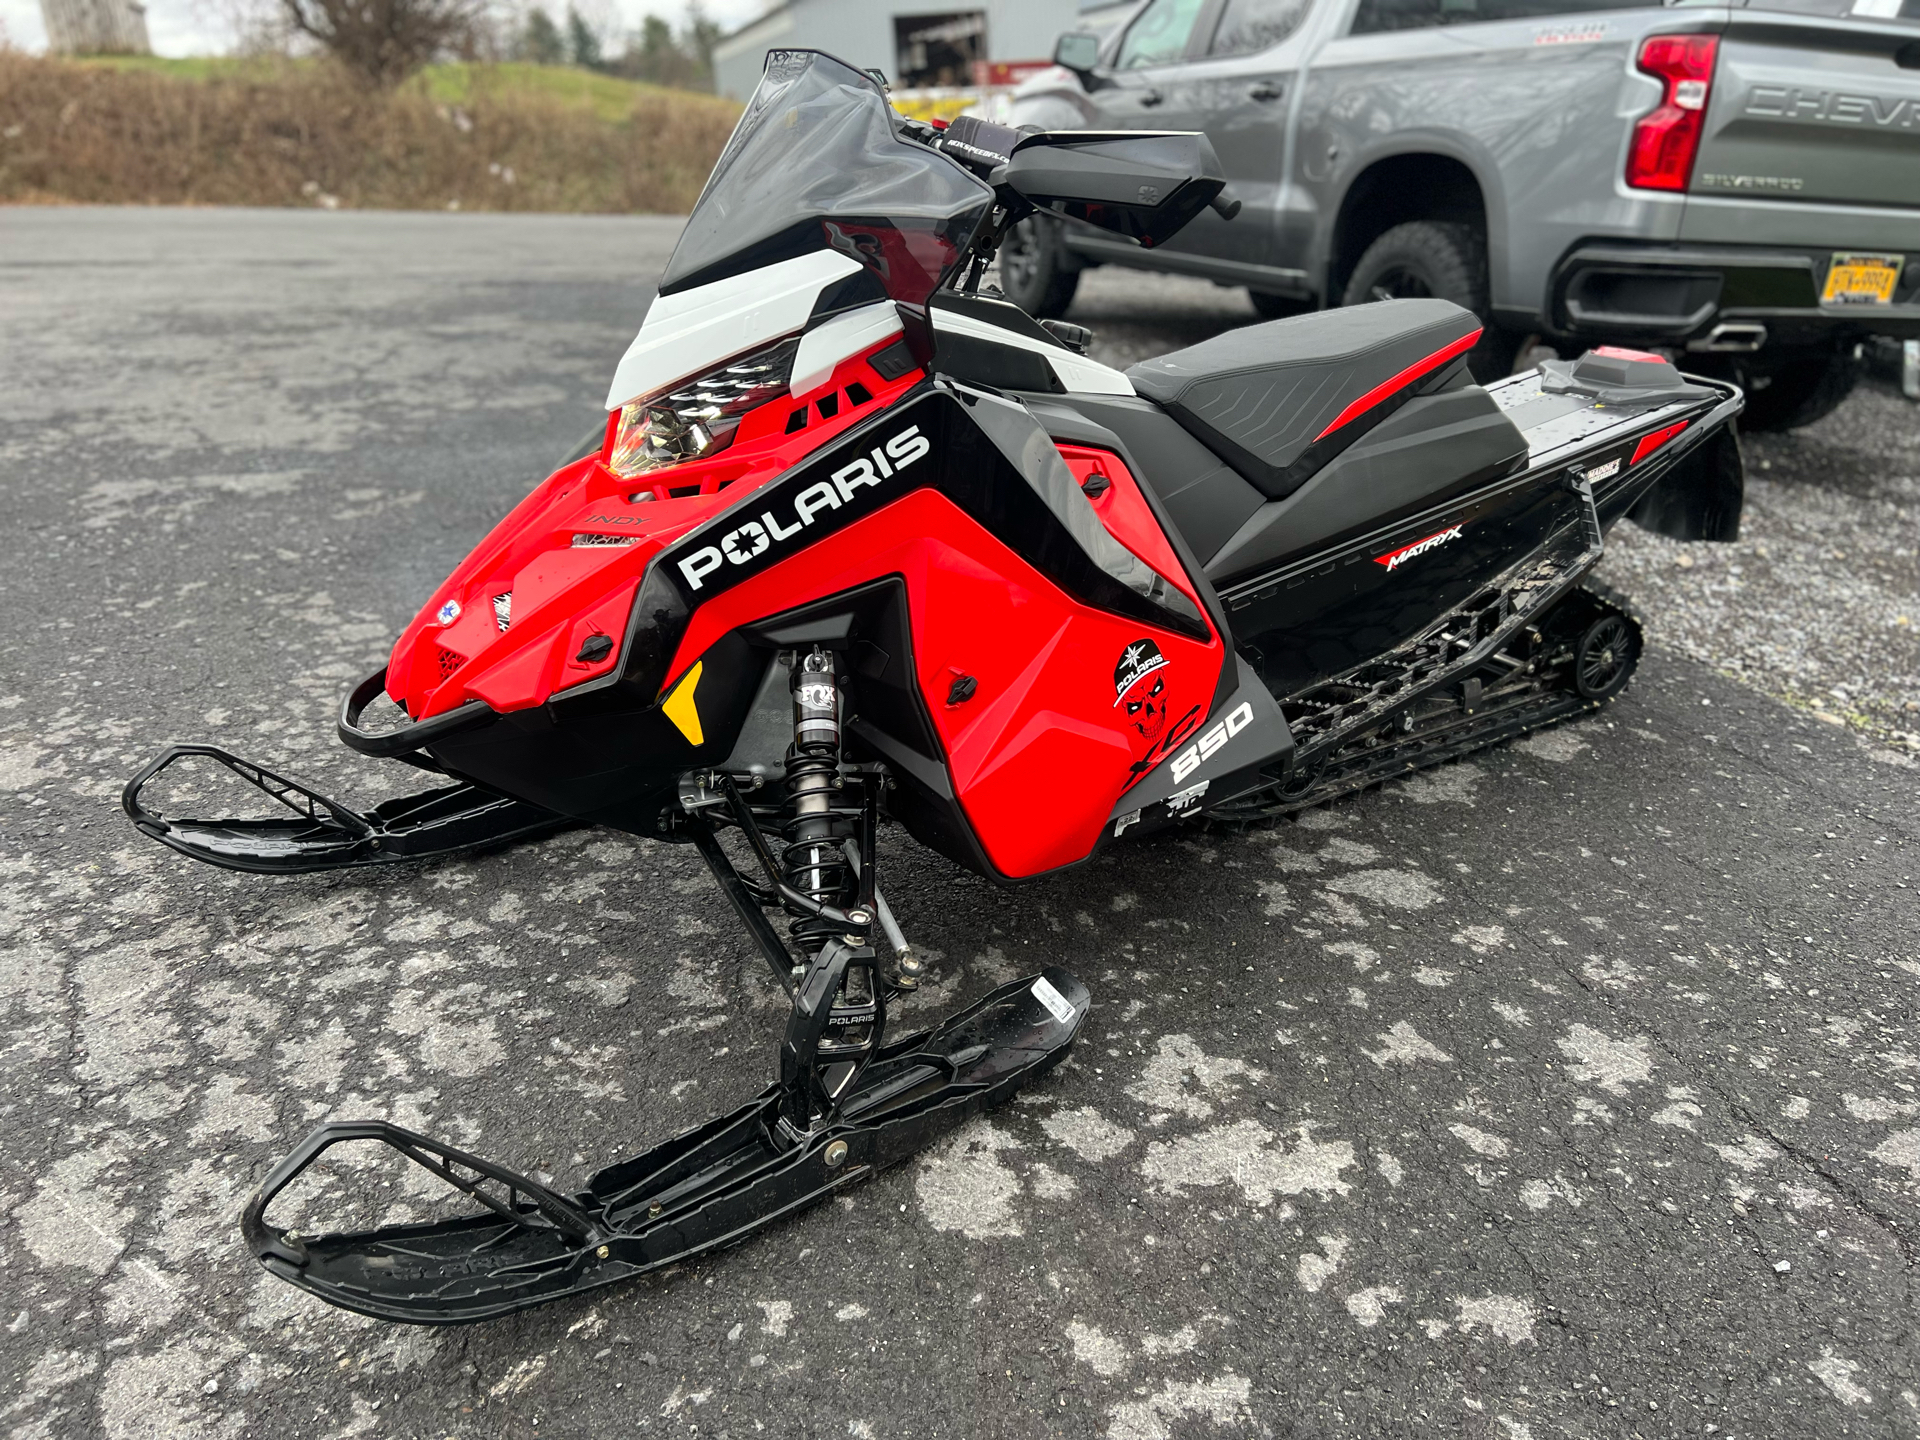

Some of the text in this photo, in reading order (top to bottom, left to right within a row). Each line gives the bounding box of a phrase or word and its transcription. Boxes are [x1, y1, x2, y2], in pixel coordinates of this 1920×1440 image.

[584, 515, 651, 526] INDY
[677, 424, 930, 591] POLARIS
[1386, 524, 1463, 572] MATRYX
[1116, 653, 1164, 694] POLARIS
[801, 684, 836, 710] FOX
[1169, 701, 1255, 785] 850
[828, 1014, 875, 1026] POLARIS
